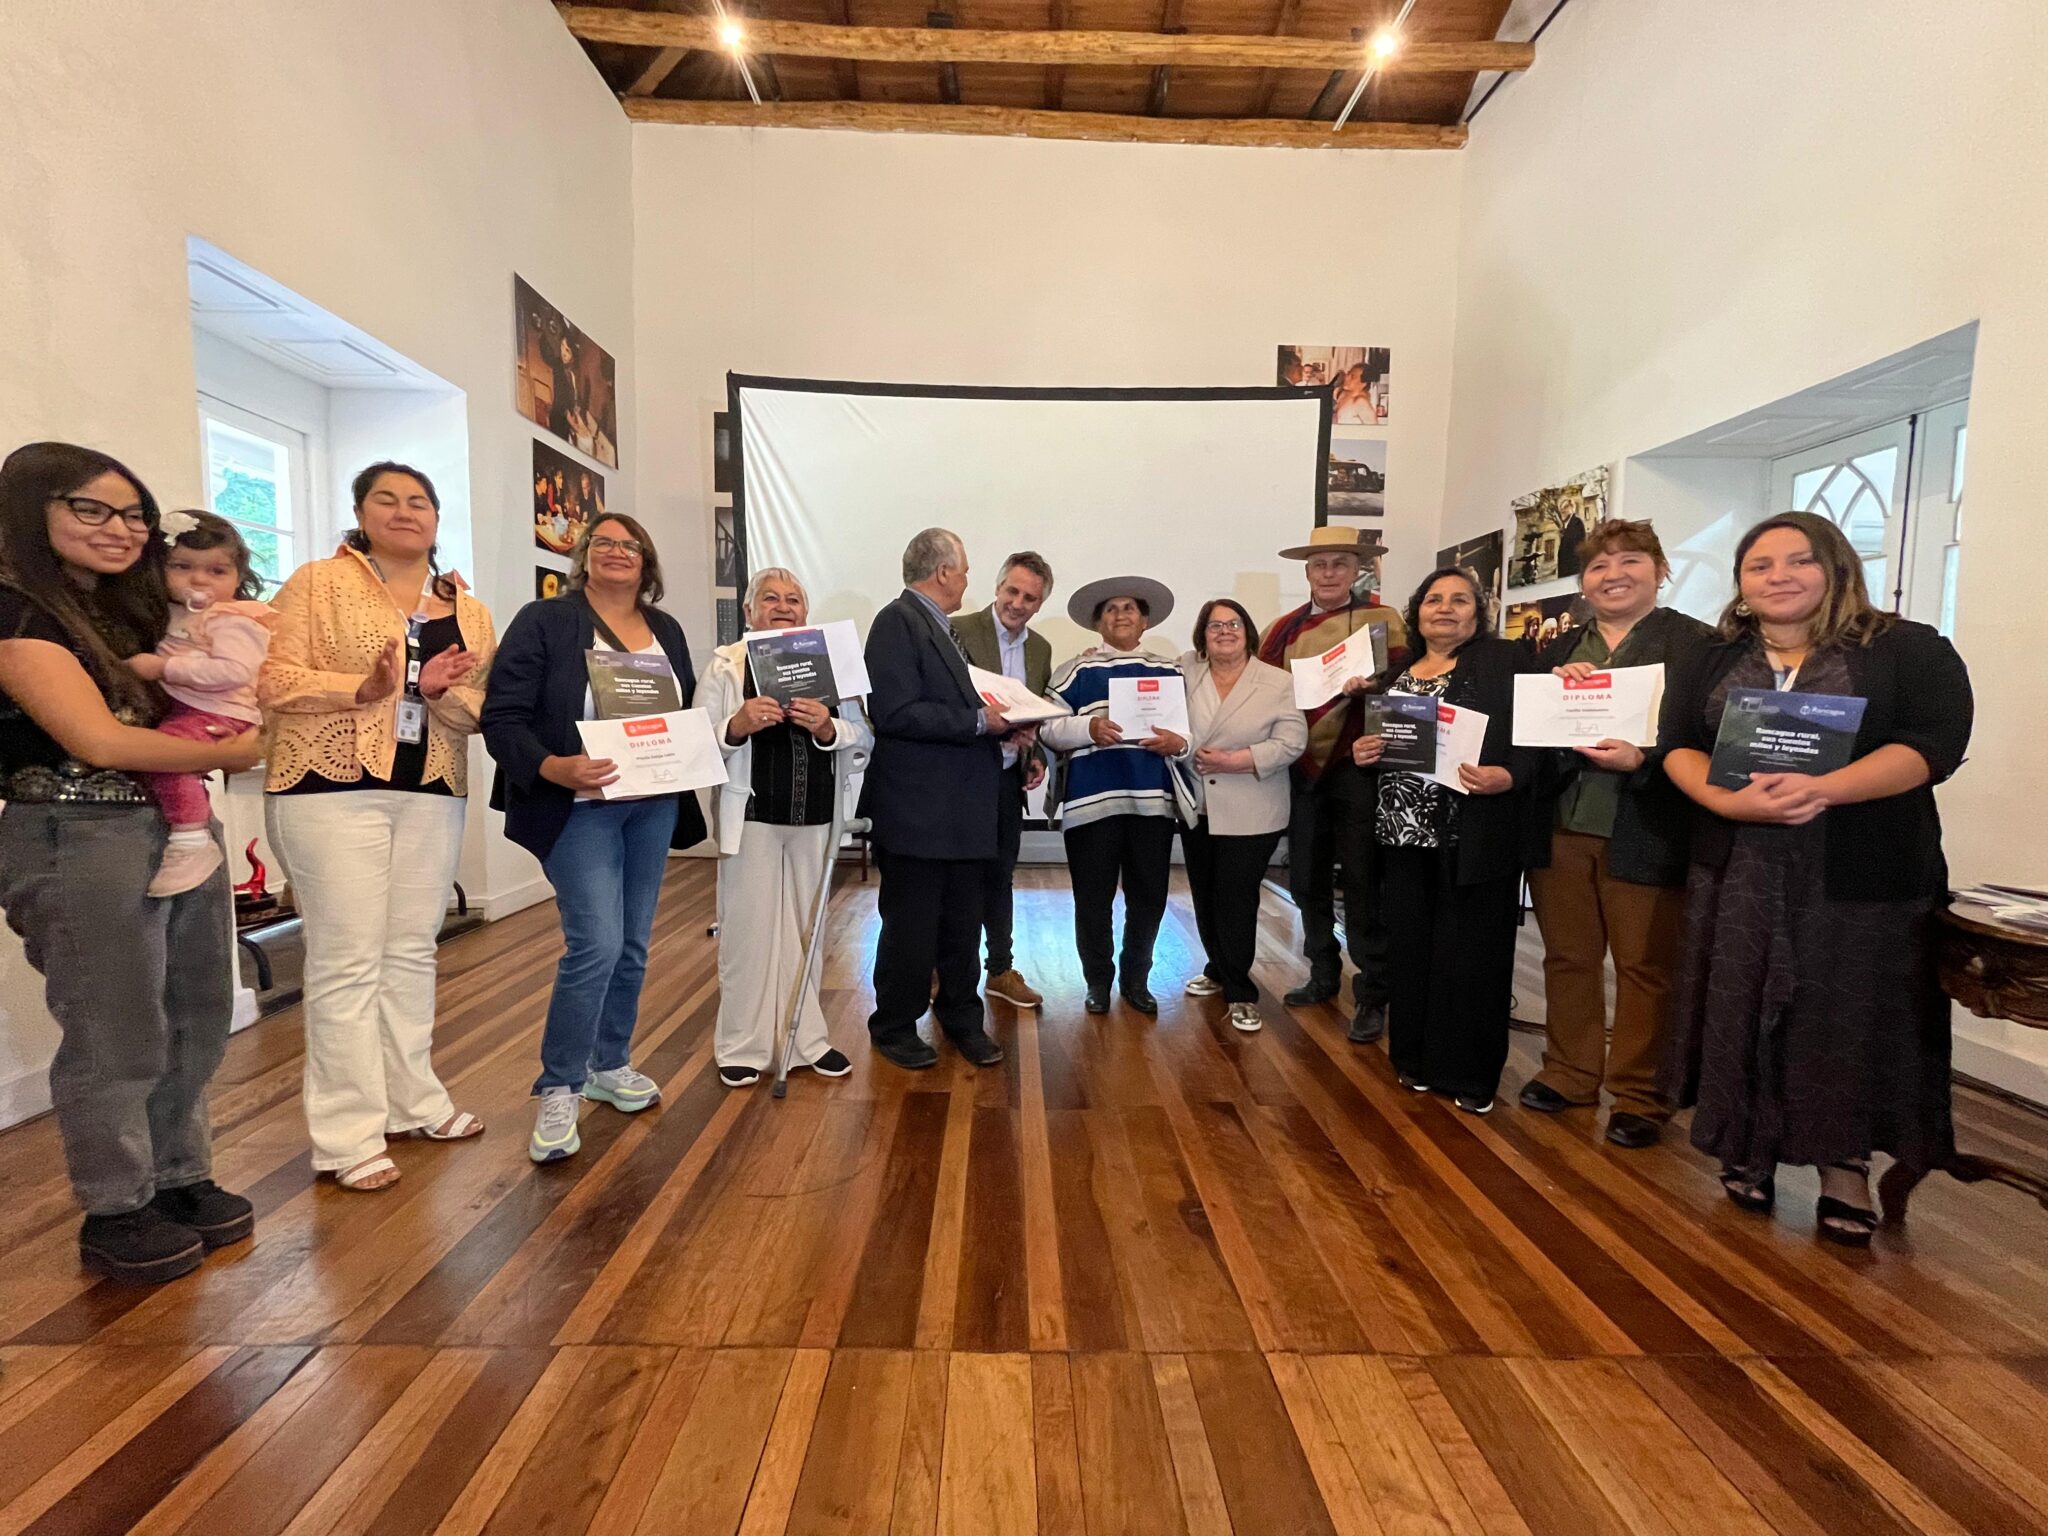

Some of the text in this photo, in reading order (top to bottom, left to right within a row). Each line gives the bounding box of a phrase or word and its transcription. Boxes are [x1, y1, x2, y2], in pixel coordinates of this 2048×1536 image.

[1562, 693, 1612, 701] DIPLOMA
[1755, 727, 1821, 740] Rancagua rural,
[629, 737, 673, 749] DIPLOMA
[1778, 738, 1811, 746] cuentos
[1774, 744, 1780, 752] y
[1781, 745, 1819, 754] leyendas
